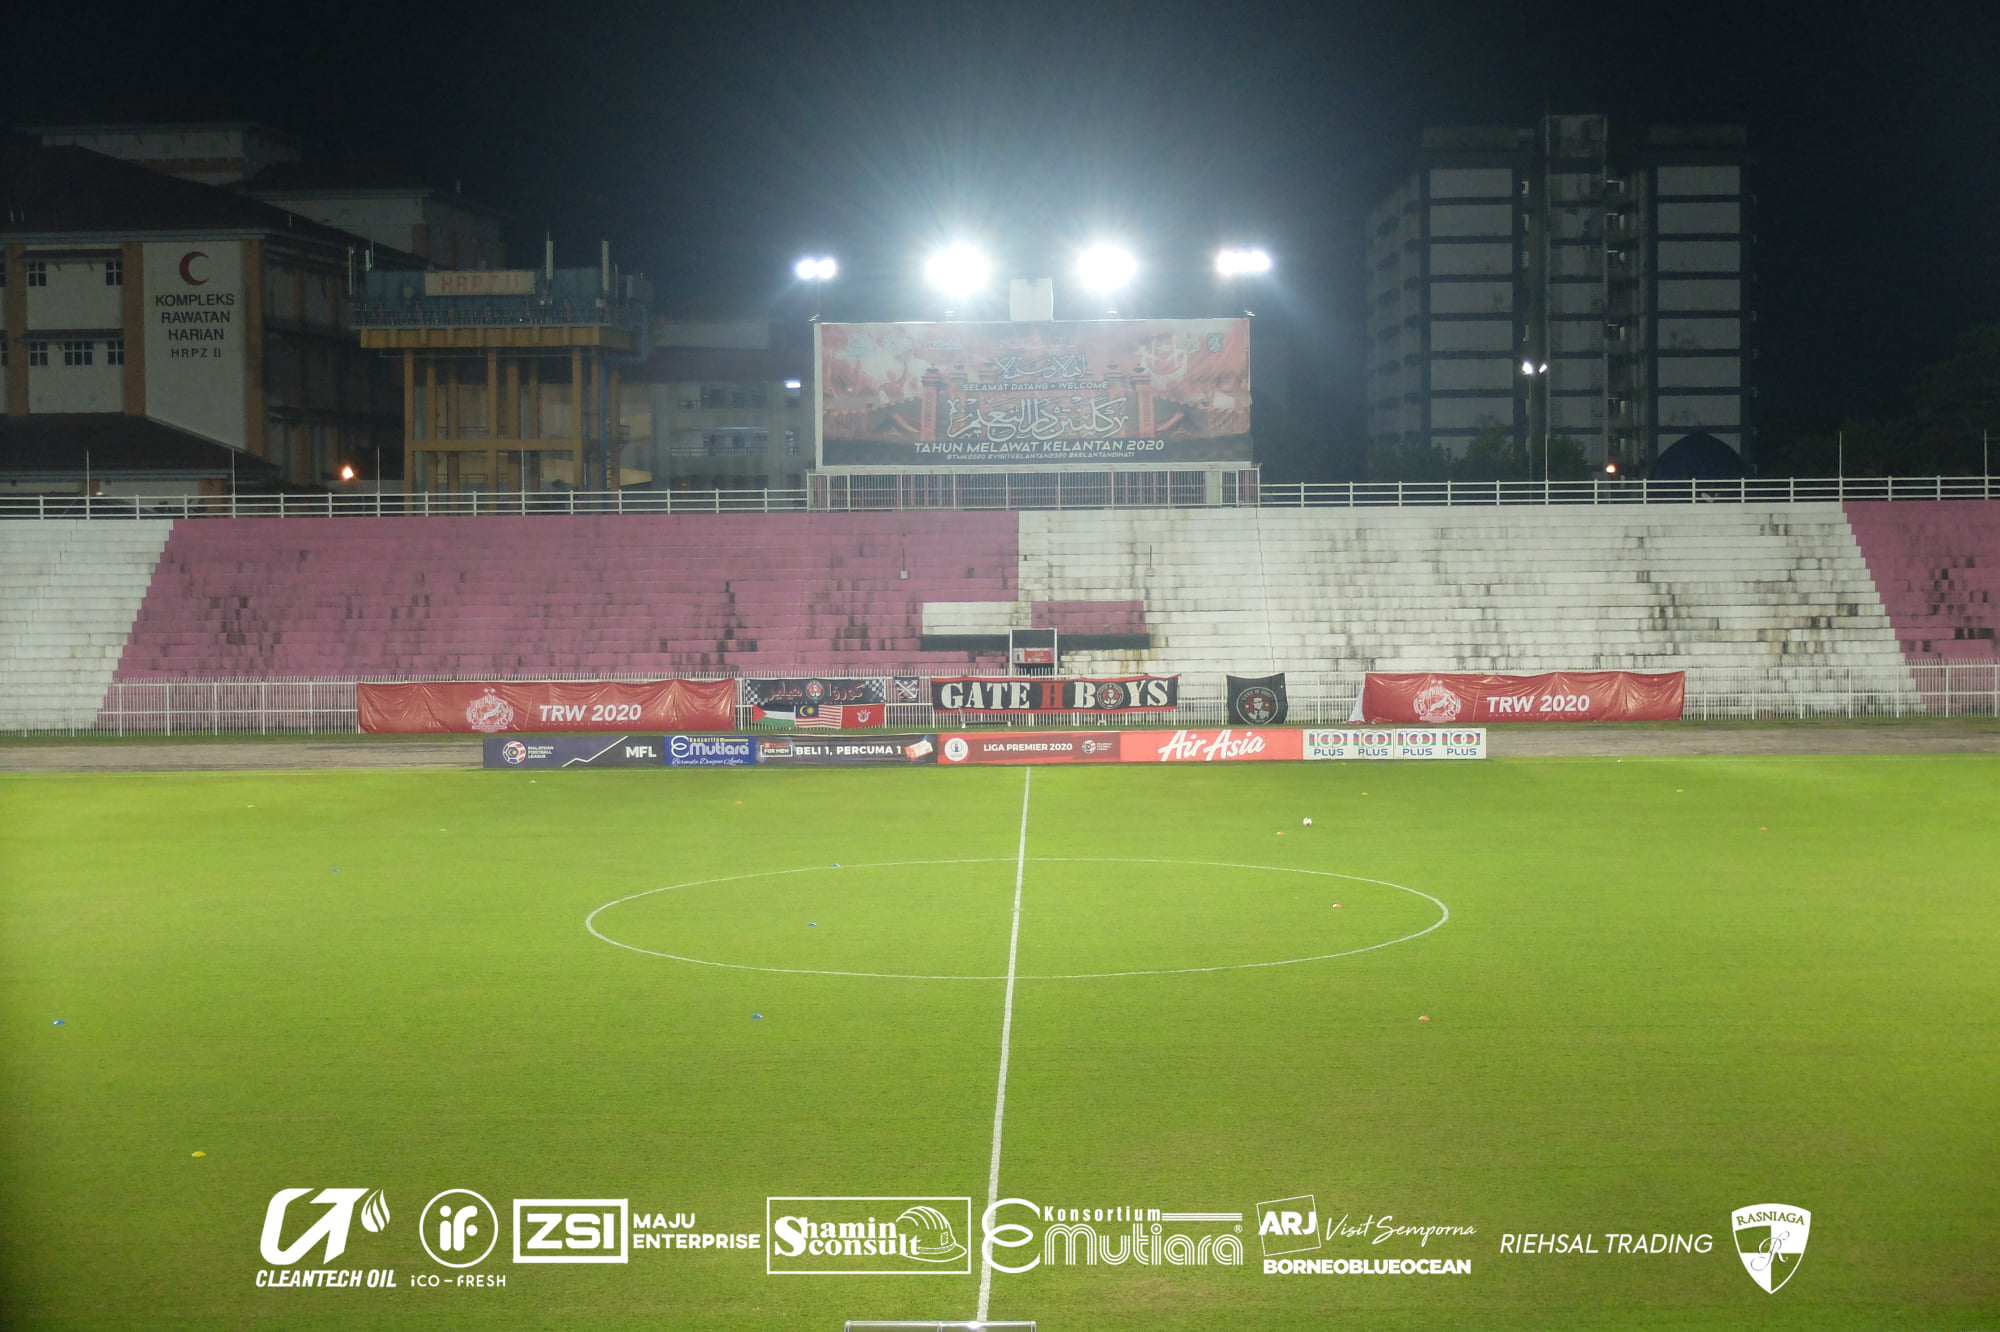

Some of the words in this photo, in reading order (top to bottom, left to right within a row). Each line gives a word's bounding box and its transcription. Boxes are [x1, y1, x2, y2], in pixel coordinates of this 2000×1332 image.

[441, 275, 498, 293] HRPZ
[155, 293, 235, 307] KOMPLEKS
[161, 311, 231, 324] RAWATAN
[168, 328, 224, 341] HARIAN
[171, 348, 208, 358] HRPZ
[962, 384, 1009, 392] SELAMAT
[1011, 383, 1049, 391] DATANG
[1058, 381, 1109, 389] WELCOME
[914, 442, 963, 453] TAHUN
[966, 442, 1040, 453] MELAWAT
[1043, 440, 1123, 452] KELANTAN
[1126, 440, 1165, 451] 2020
[941, 682, 1031, 709] GATE
[1041, 683, 1064, 709] H
[1486, 696, 1535, 713] TRW
[1540, 695, 1590, 712] 2020
[540, 705, 587, 722] TRW
[591, 704, 642, 721] 2020
[1311, 731, 1345, 747] 100
[1356, 731, 1389, 747] 100
[1400, 731, 1434, 747] 100
[1444, 731, 1478, 747] 100
[625, 746, 657, 758] MFL
[796, 747, 821, 755] BELI
[824, 746, 833, 756] 1,
[837, 746, 893, 755] PERCUMA
[896, 745, 901, 755] 1
[983, 743, 1006, 752] LIGA
[1007, 743, 1047, 751] PREMIER
[1049, 743, 1073, 751] 2020
[1314, 748, 1344, 756] PLUS
[1358, 748, 1388, 756] PLUS
[1402, 748, 1432, 756] PLUS
[1446, 748, 1477, 756] PLUS
